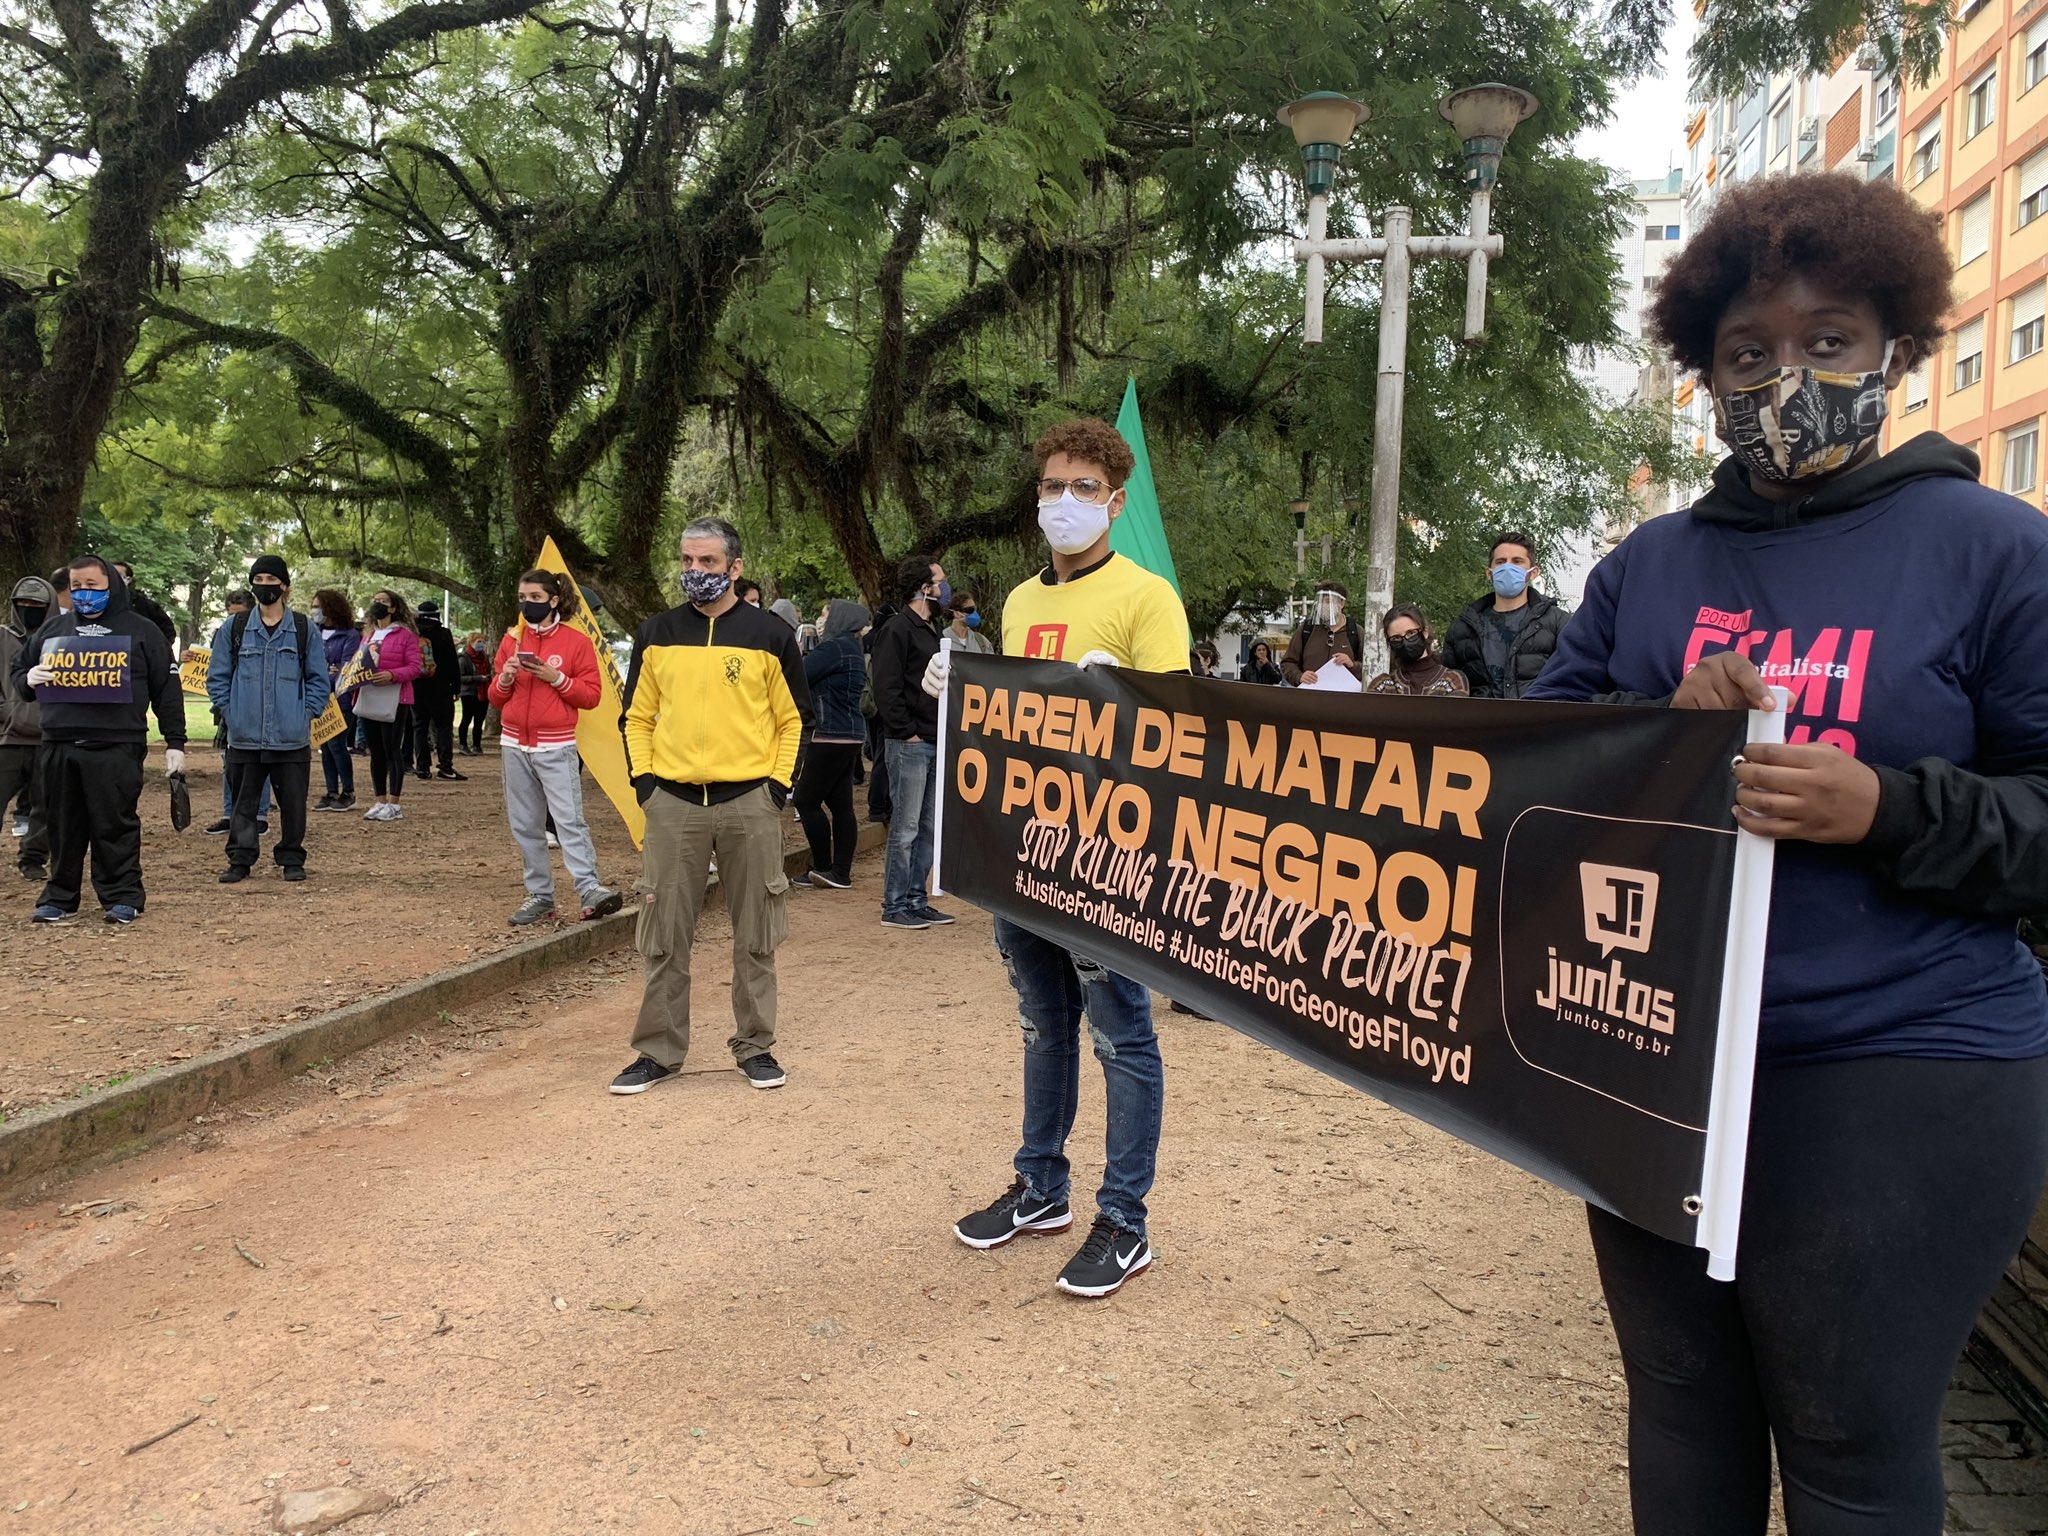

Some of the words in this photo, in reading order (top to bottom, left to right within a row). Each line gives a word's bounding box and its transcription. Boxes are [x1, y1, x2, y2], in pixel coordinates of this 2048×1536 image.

[79, 651, 128, 668] VITOR
[1699, 609, 1729, 628] POR
[44, 669, 121, 687] RESENTE!
[961, 684, 1117, 760] PAREM
[1130, 707, 1207, 778] DE
[1224, 720, 1491, 840] MATAR
[956, 747, 988, 804] O
[1001, 757, 1152, 851] POVO
[1171, 796, 1478, 961] NEGRO!
[1017, 817, 1069, 873] STOP
[1161, 859, 1218, 929] THE
[1219, 878, 1321, 964] BLACK
[1322, 910, 1471, 1032] PEOPLE!
[1015, 870, 1165, 953] #JusticeForMarielle
[1169, 929, 1471, 1084] #JusticeForGeorgeFloyd
[1535, 946, 1676, 1035] juntos
[1556, 1004, 1672, 1056] juntos.org.br
